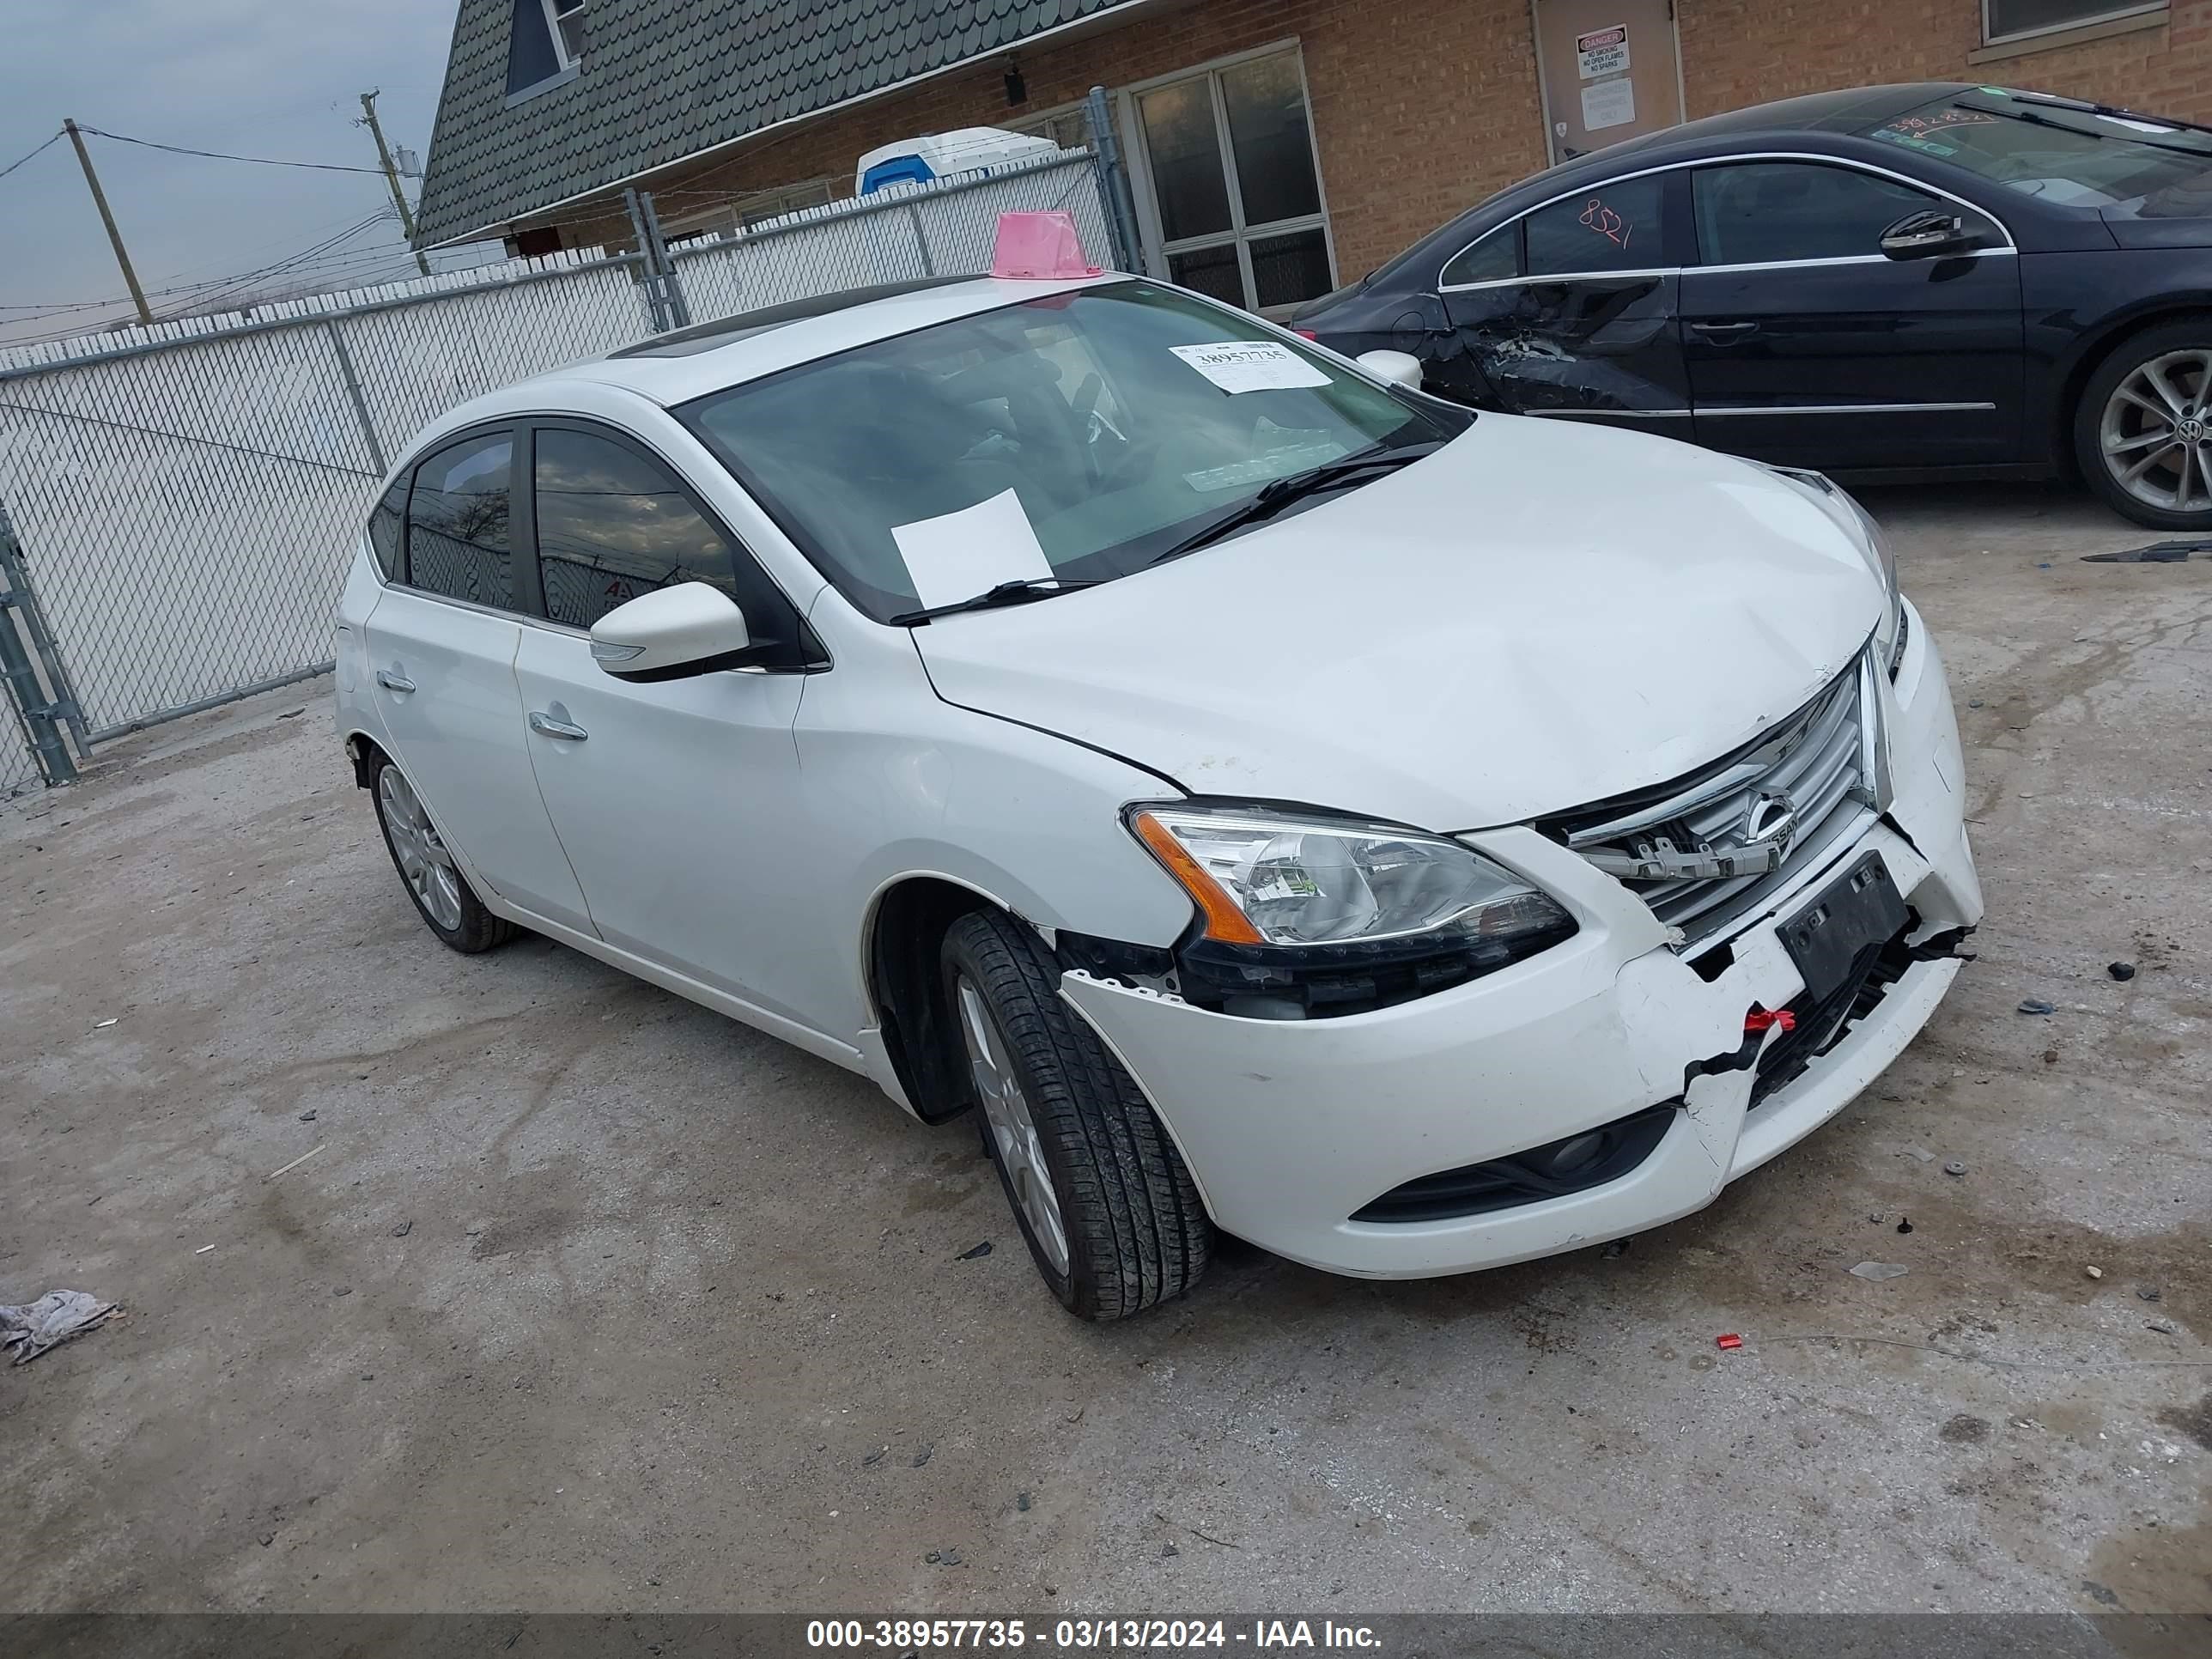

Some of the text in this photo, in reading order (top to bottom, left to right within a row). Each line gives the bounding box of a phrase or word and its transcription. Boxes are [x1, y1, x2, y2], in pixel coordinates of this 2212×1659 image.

[1584, 33, 1620, 49] DANGER
[1583, 51, 1625, 67] NO OPEN FLAMES
[1588, 45, 1618, 58] NO SMOKING
[1598, 59, 1618, 71] SPARKS
[1578, 198, 1635, 251] 8521
[1196, 350, 1288, 366] 38957735
[1765, 817, 1798, 844] SSAN
